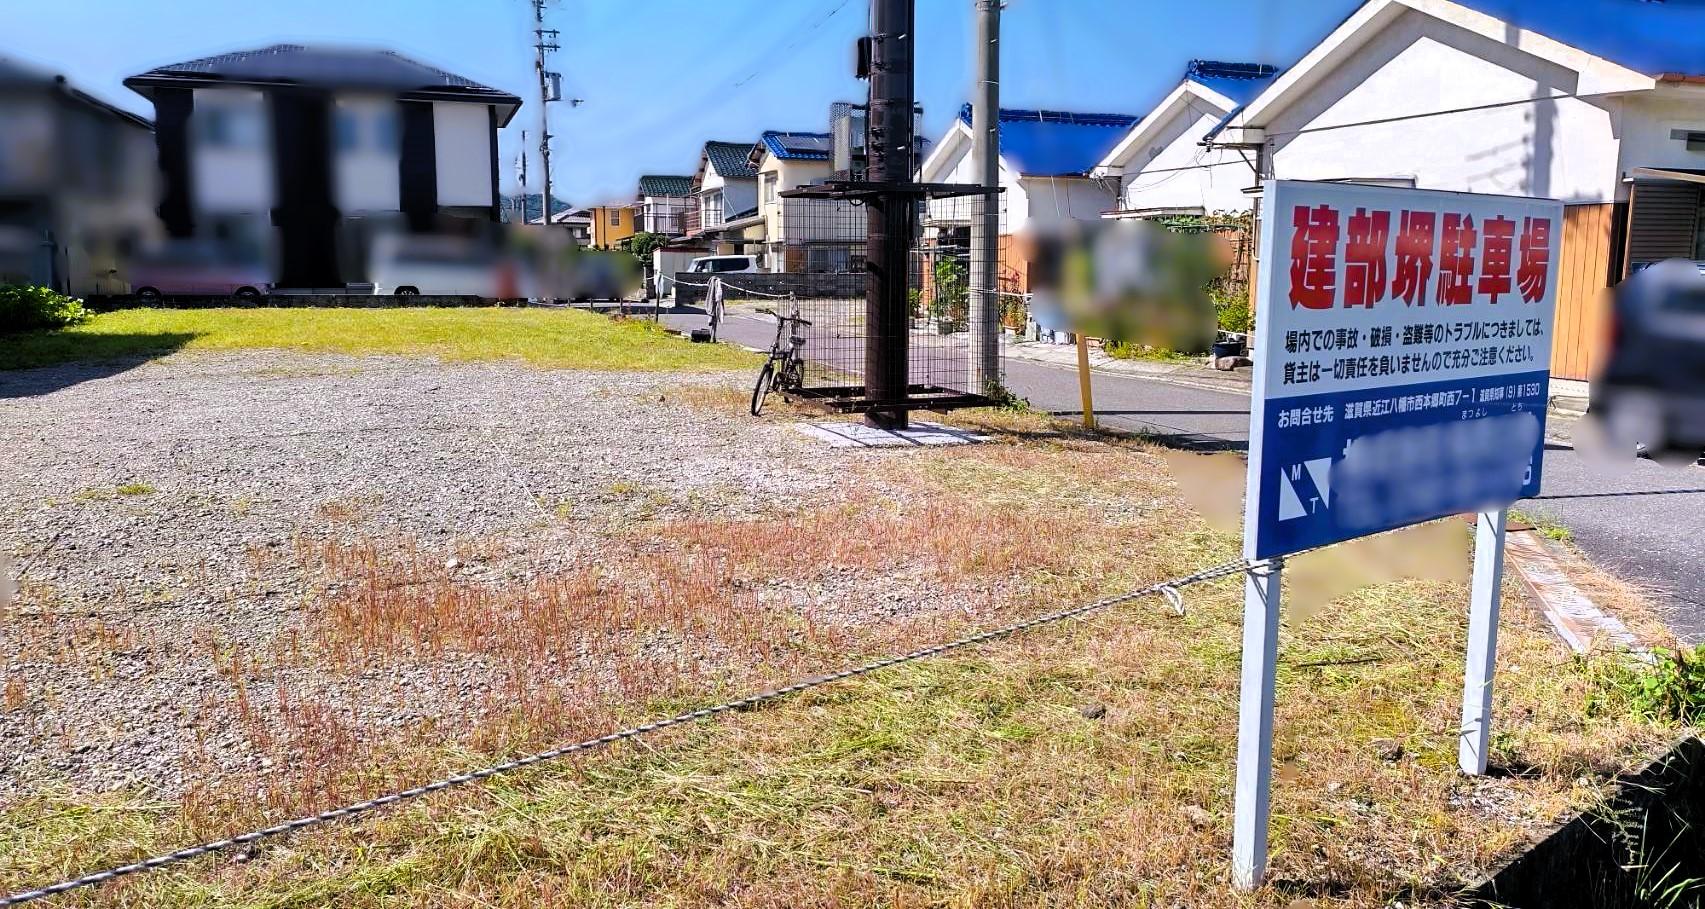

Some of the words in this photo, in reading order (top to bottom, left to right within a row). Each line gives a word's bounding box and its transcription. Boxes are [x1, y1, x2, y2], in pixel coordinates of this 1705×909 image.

[1289, 203, 1551, 311] 建部堺駐車場
[1283, 345, 1535, 385] 貸主は一切責任を負いませんので充分ご注意ください。
[1277, 404, 1334, 429] お問合せ先
[1291, 463, 1302, 482] M
[1309, 496, 1320, 514] T
